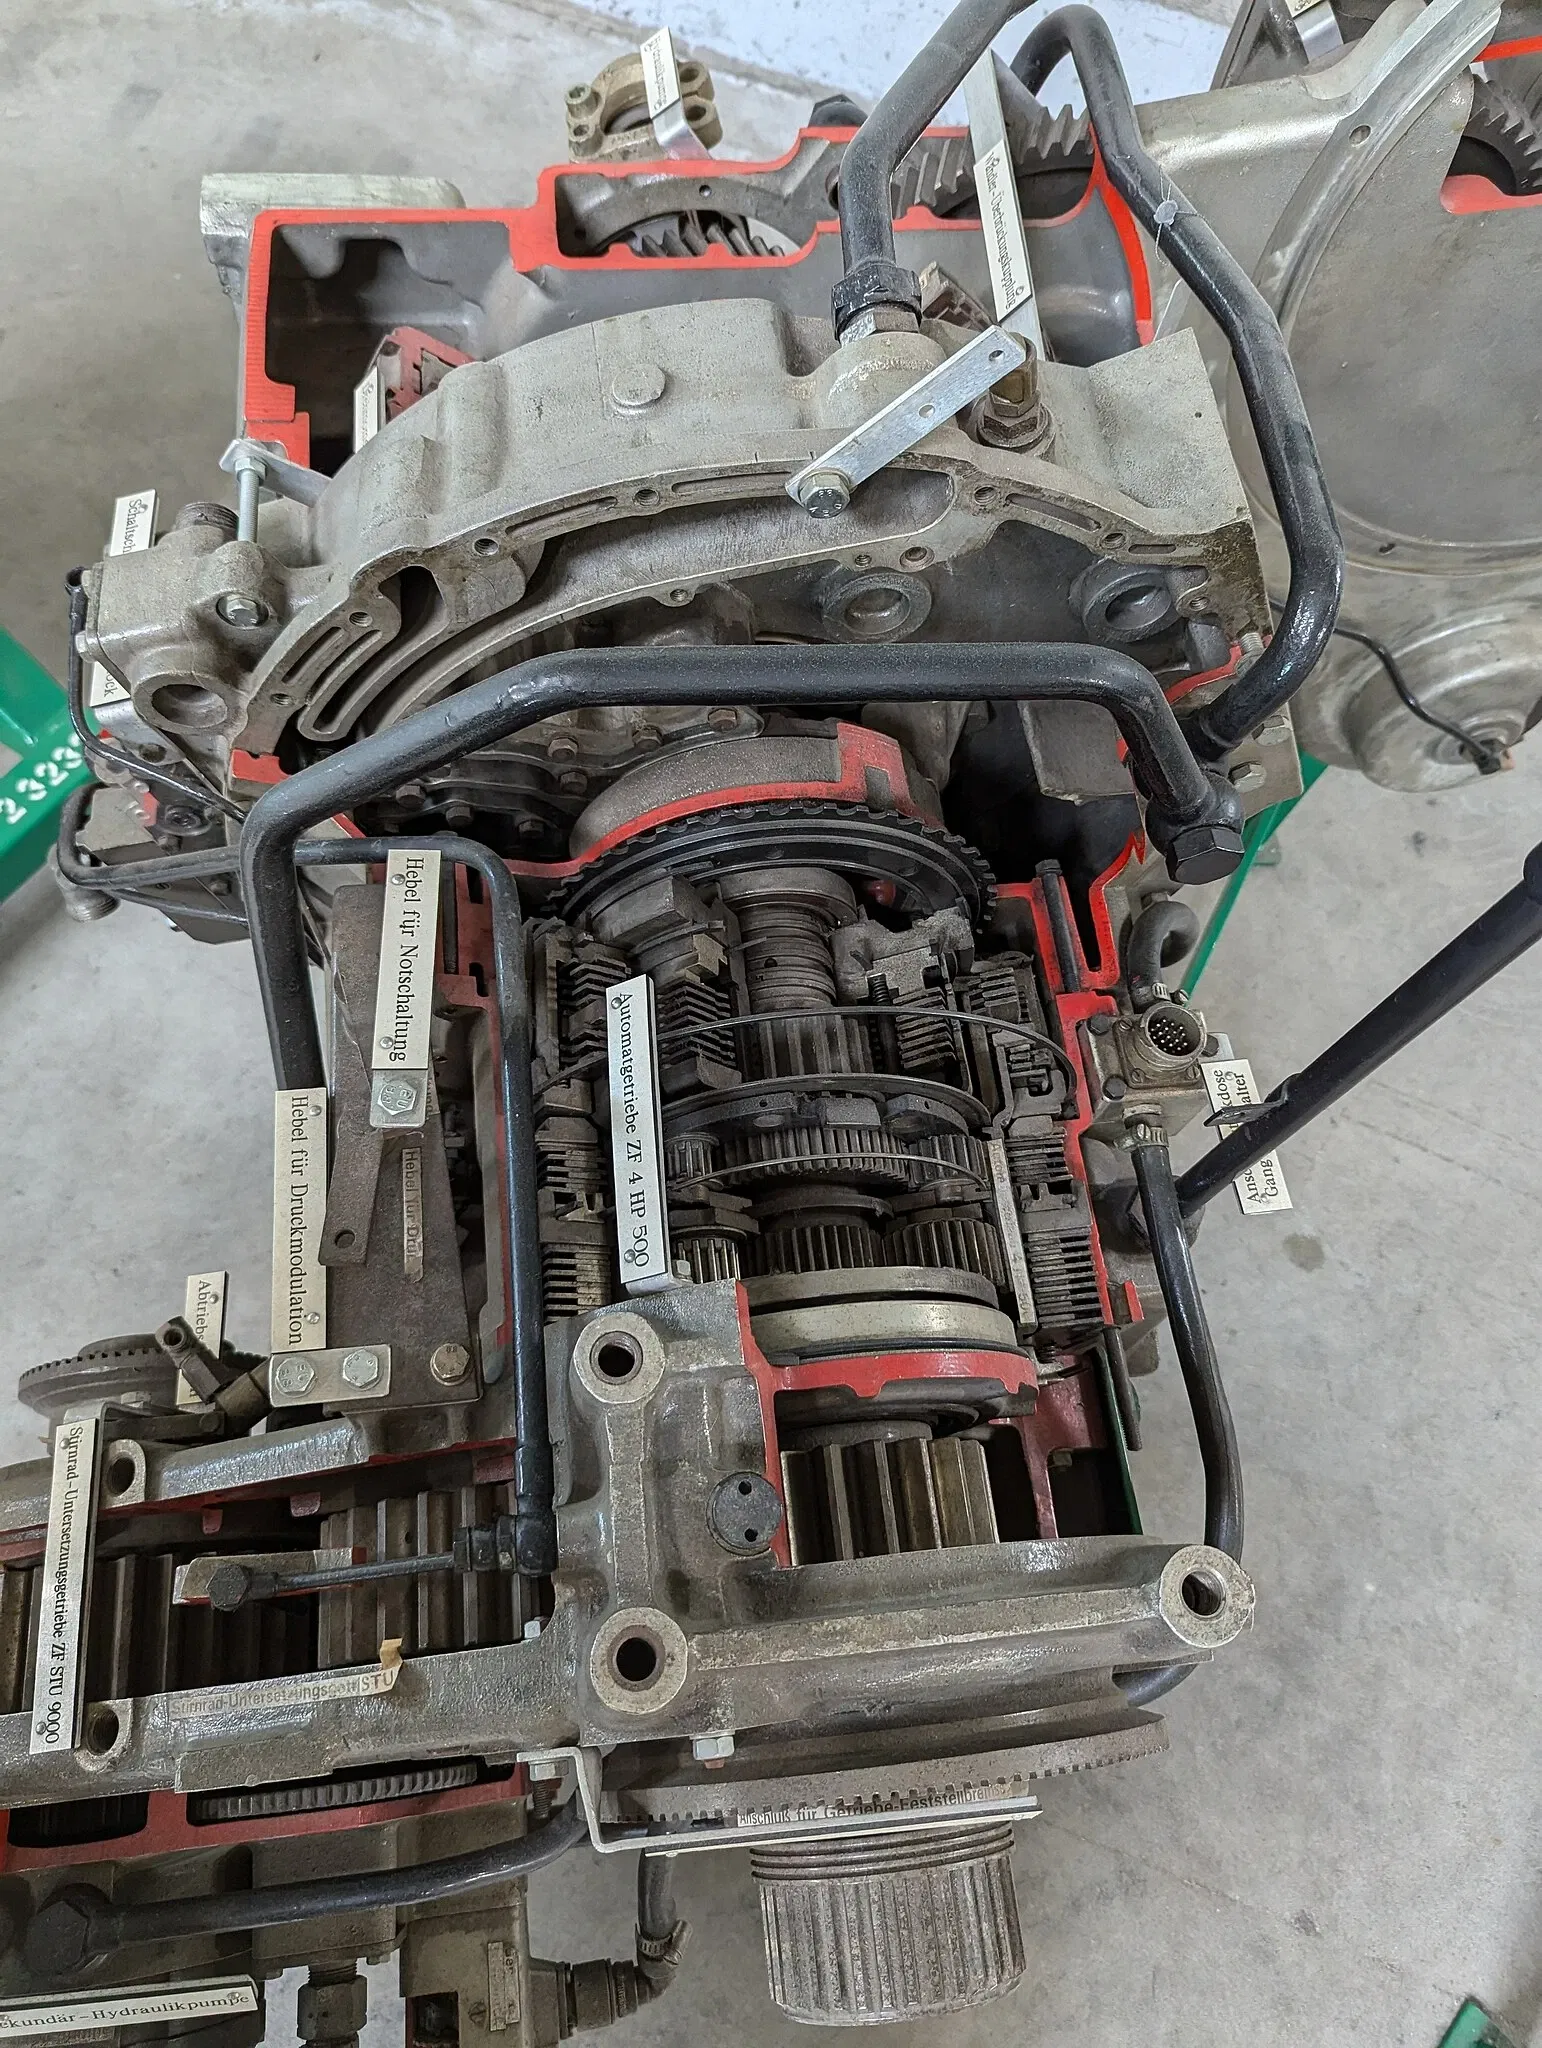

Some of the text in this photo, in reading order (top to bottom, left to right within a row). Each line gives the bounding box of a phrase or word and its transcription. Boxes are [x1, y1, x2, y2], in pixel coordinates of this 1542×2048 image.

[404, 857, 425, 903] Hebel
[400, 909, 420, 937] für
[389, 944, 419, 1062] Notschaltung
[291, 1095, 309, 1143] Hebel
[618, 992, 650, 1268] Automatgetriebe ZF 4 HP 500
[291, 1149, 309, 1176] für
[405, 1151, 419, 1192] Hebel
[288, 1182, 309, 1346] Druckmodulation
[51, 1641, 66, 1661] ZF
[48, 1666, 64, 1697] STU
[361, 1671, 395, 1692] STU
[45, 1700, 62, 1744] 9000
